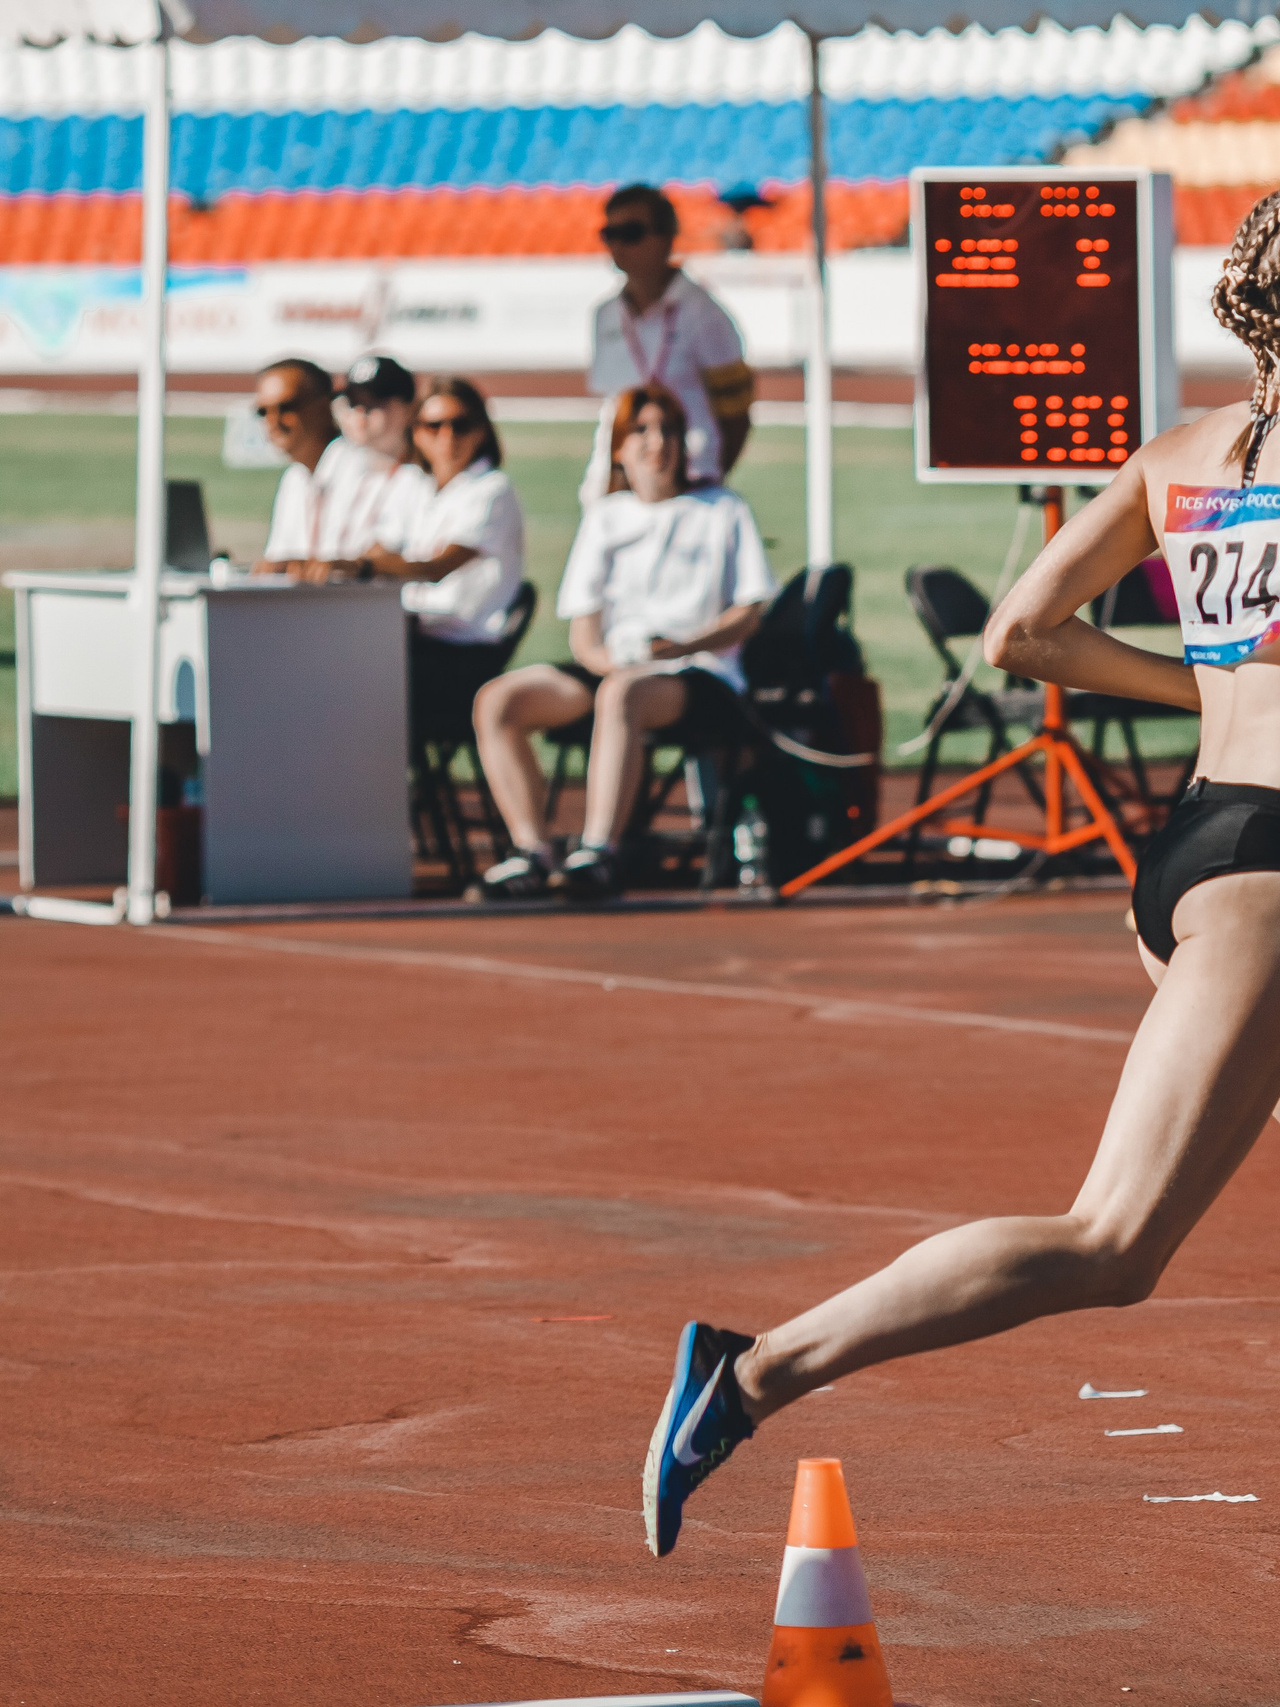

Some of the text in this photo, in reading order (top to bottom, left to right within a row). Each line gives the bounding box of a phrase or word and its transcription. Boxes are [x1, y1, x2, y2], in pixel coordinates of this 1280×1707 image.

[1175, 495, 1203, 510] ПСБ
[1205, 496, 1244, 512] КУБ
[1190, 540, 1280, 625] 274
